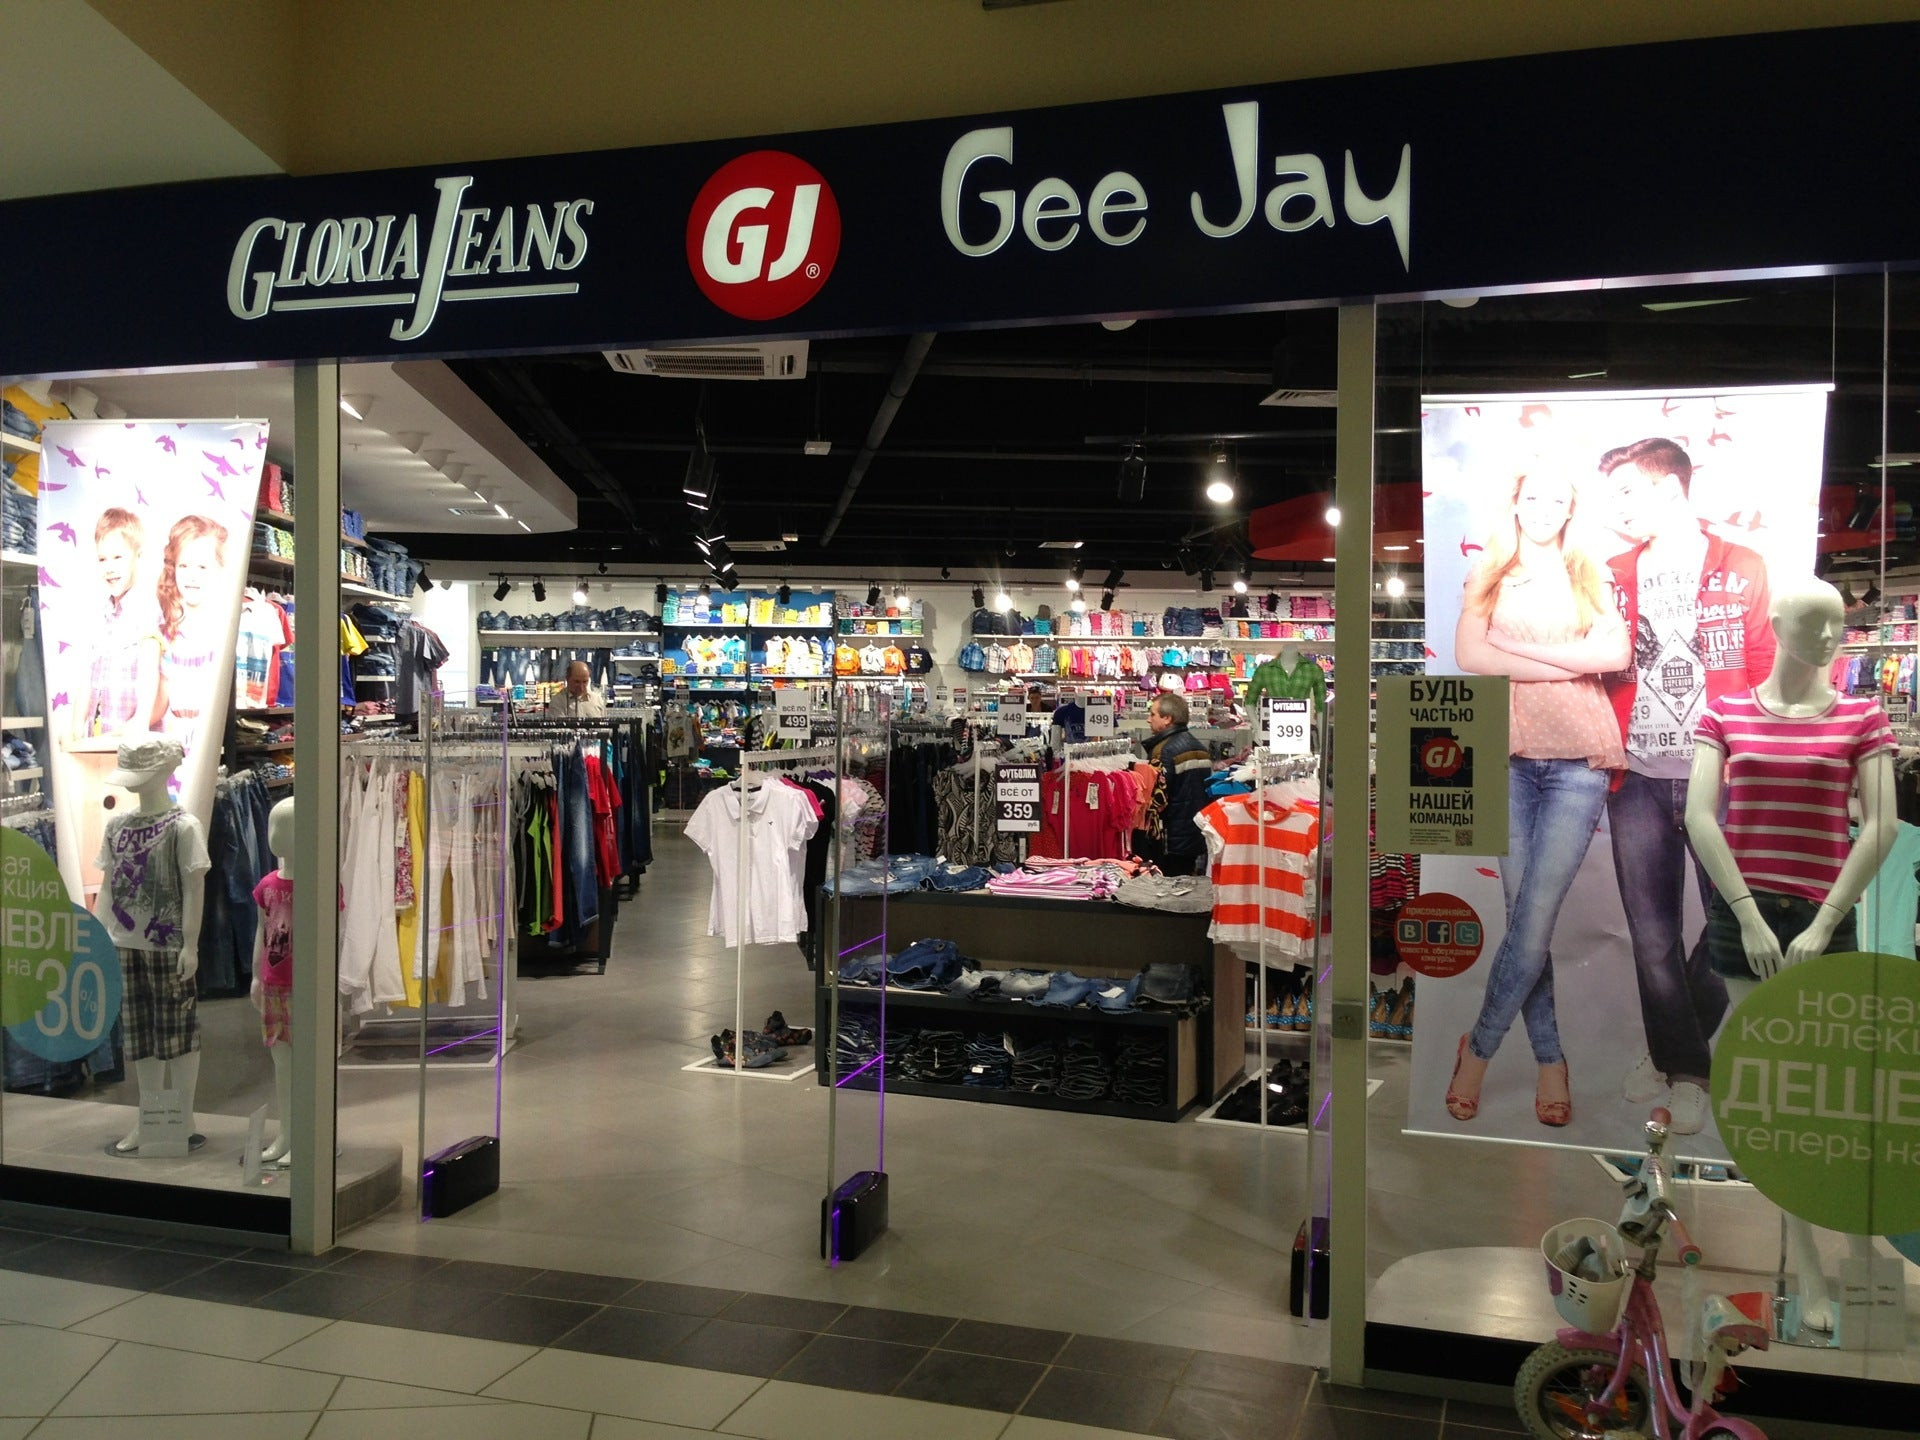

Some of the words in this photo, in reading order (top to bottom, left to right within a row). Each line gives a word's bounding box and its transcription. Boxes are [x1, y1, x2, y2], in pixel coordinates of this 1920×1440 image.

[941, 126, 1148, 257] Gee
[1190, 100, 1411, 273] Jay
[1410, 680, 1474, 705] БУДЬ
[785, 715, 806, 727] 499
[1003, 713, 1022, 722] 449
[1089, 714, 1109, 724] 499
[1410, 707, 1474, 721] ЧАСТЬЮ
[1277, 725, 1304, 738] 399
[1425, 746, 1456, 768] GJ
[1000, 768, 1037, 779] ФУТБОЛКА
[1021, 788, 1034, 797] ОТ
[1410, 790, 1474, 810] НАШЕЙ
[1003, 803, 1033, 819] 359
[1410, 812, 1474, 827] КОМАНДЫ
[4, 856, 31, 876] ая
[3, 879, 59, 901] кция
[6, 958, 31, 976] на
[35, 958, 106, 1040] 30
[1798, 989, 1920, 1025] нова
[1719, 1056, 1920, 1127] ДЕШЕ
[1727, 1124, 1872, 1165] теперь
